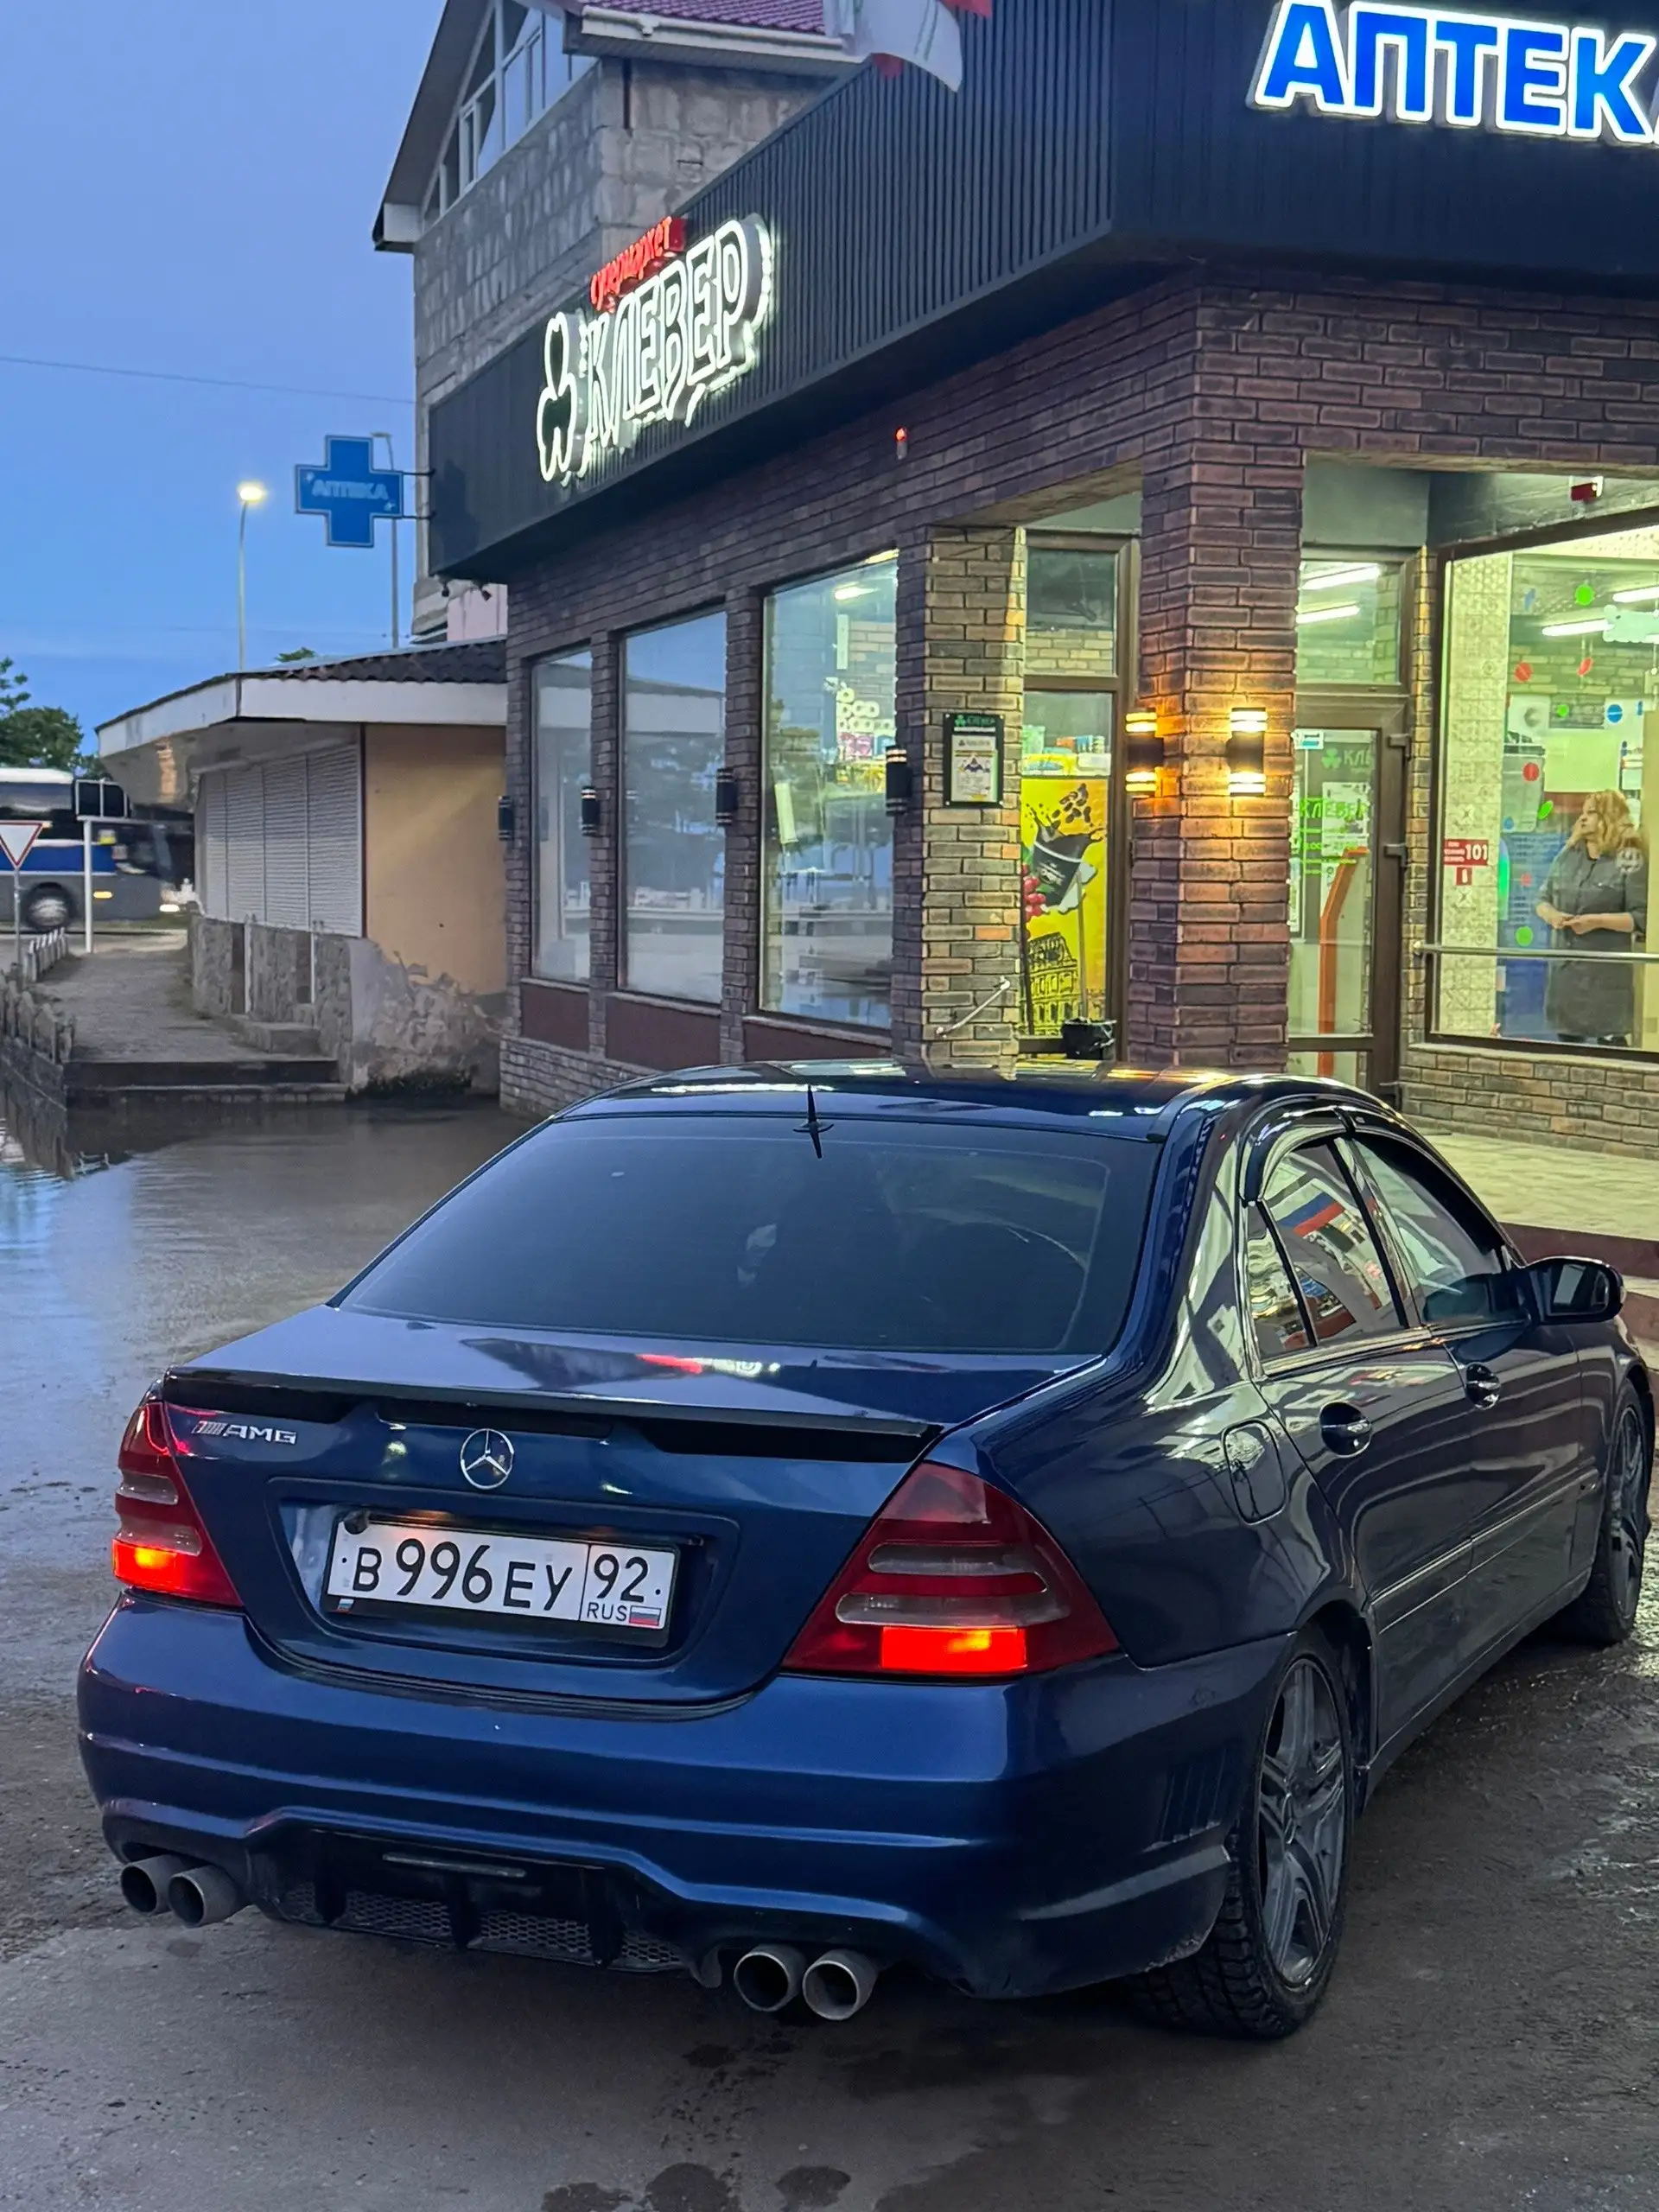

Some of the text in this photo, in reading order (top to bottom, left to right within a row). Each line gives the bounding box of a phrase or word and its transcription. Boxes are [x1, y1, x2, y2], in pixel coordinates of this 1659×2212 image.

[1253, 0, 1659, 143] АПТЕК
[588, 219, 750, 448] КЛЕВЕР
[1465, 843, 1487, 860] 101
[223, 1425, 296, 1445] AMG
[594, 1554, 649, 1603] 92
[587, 1602, 627, 1622] RUS
